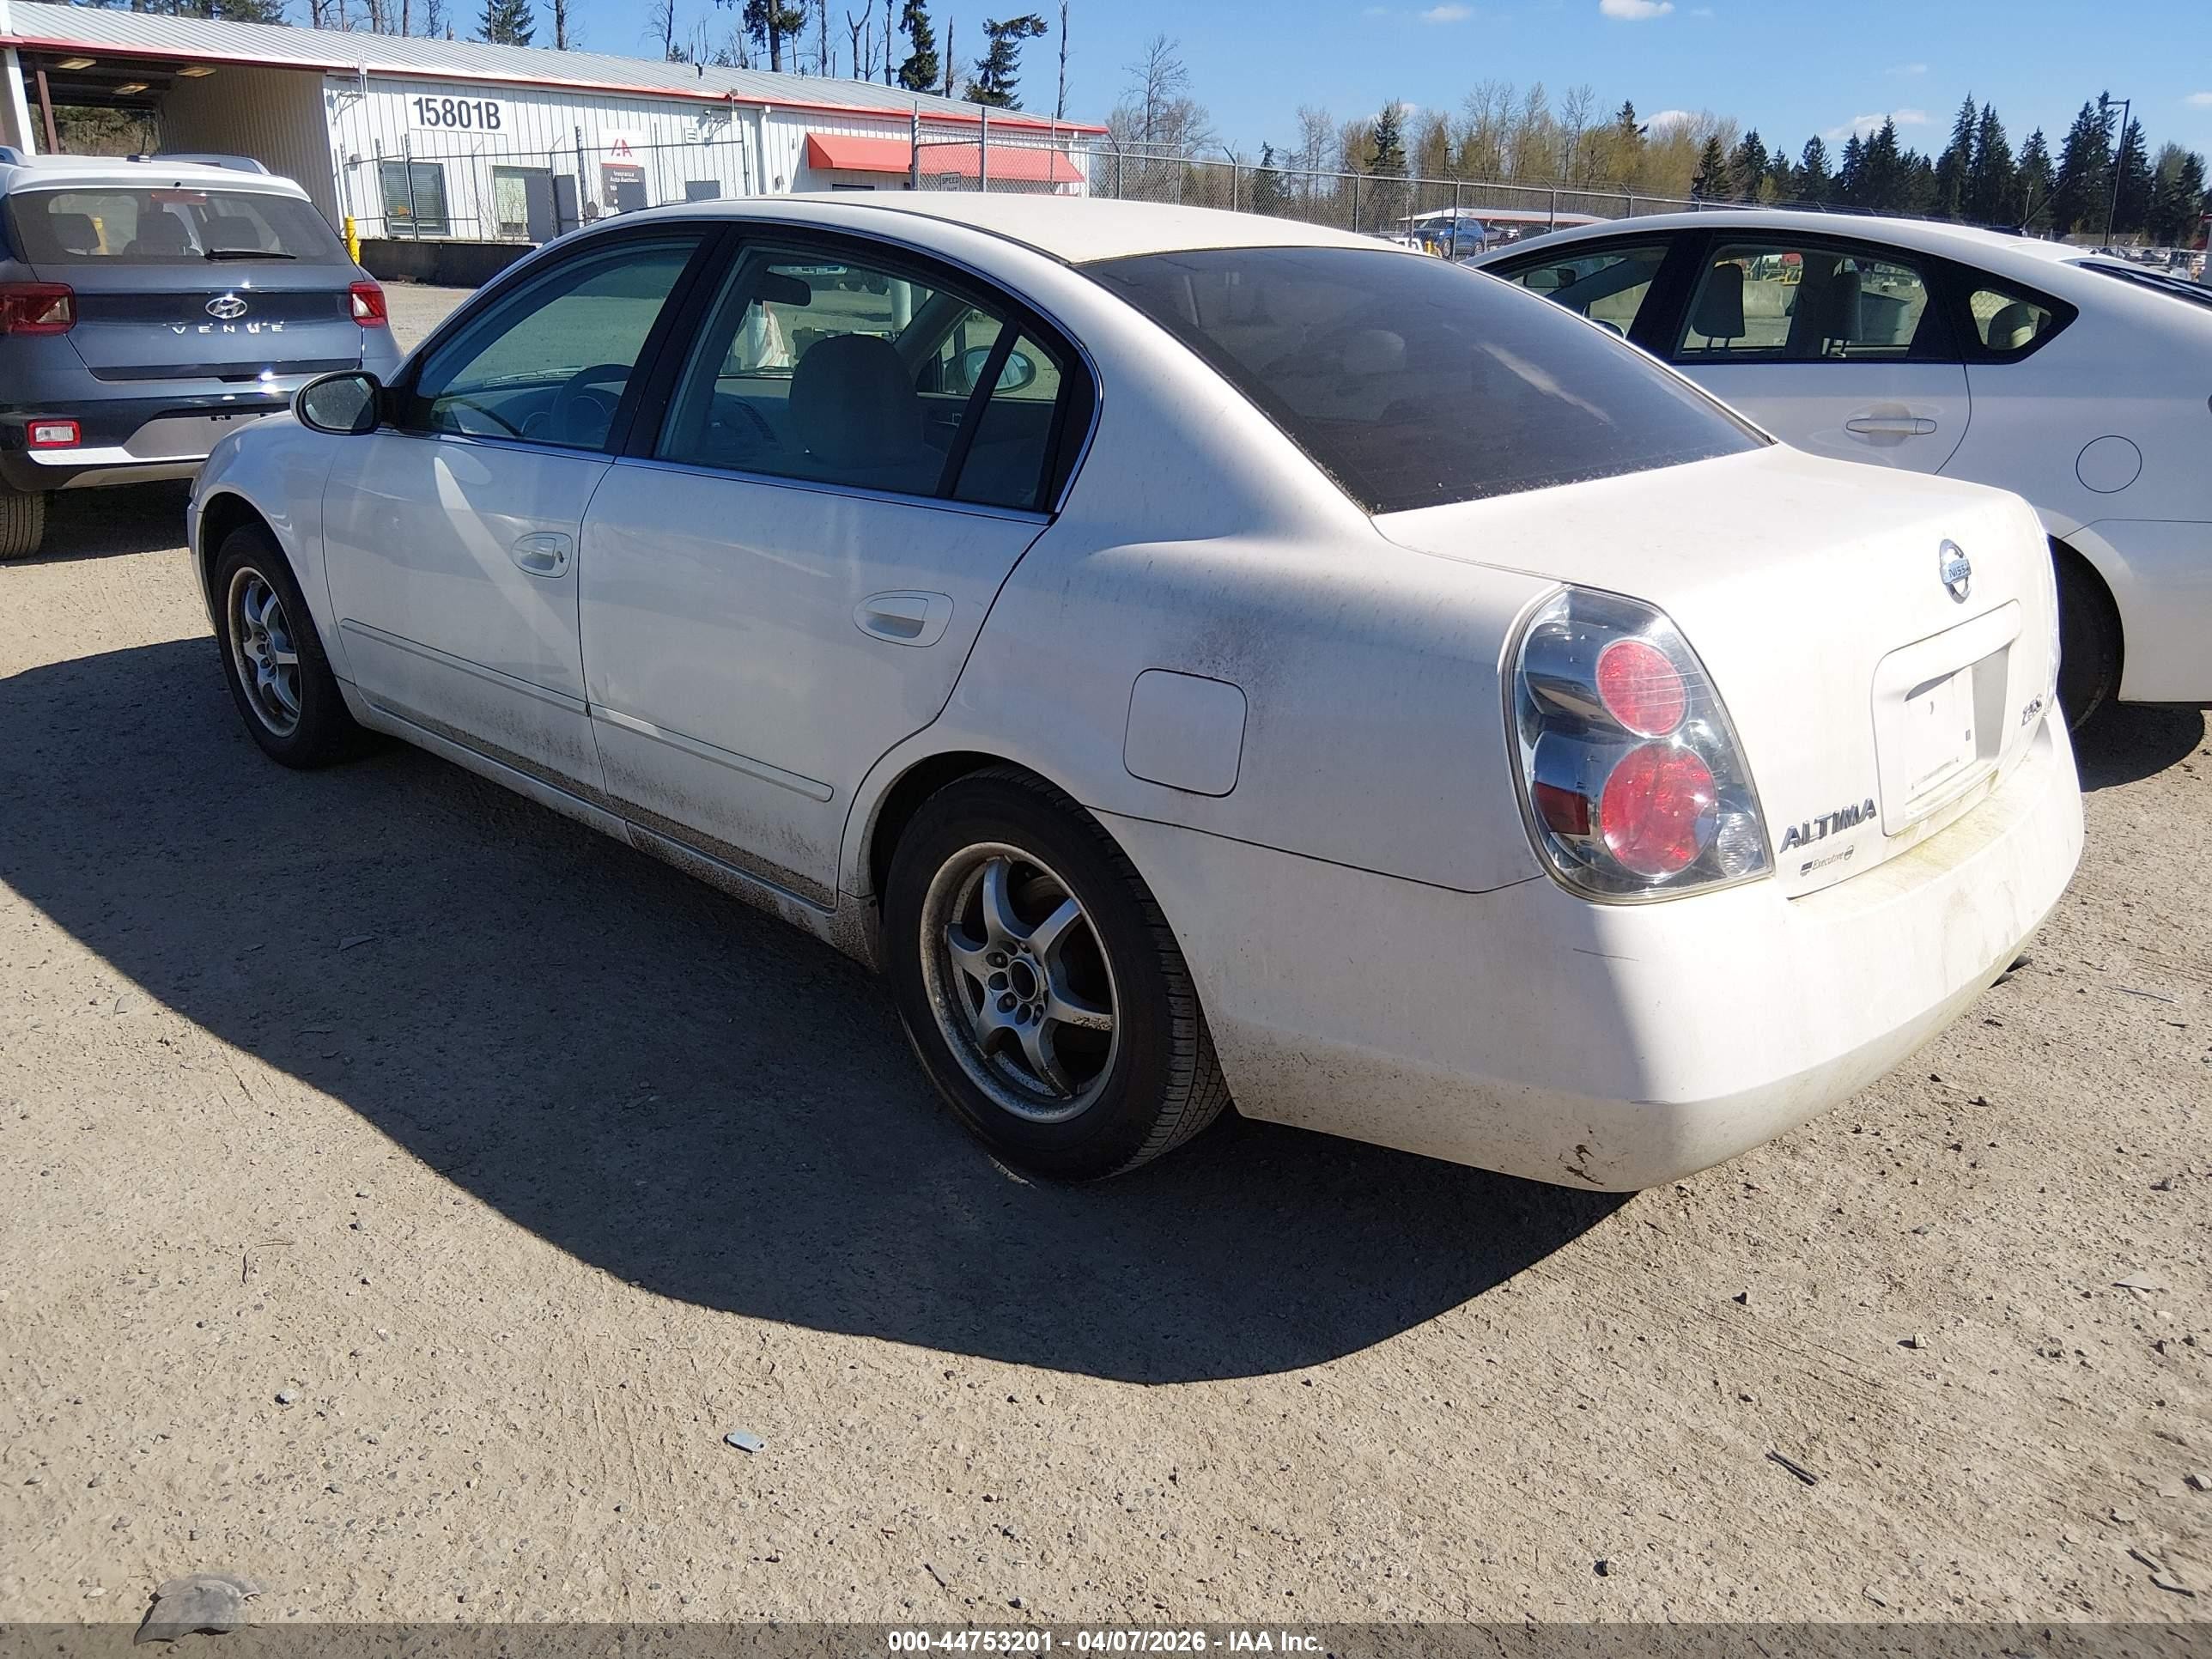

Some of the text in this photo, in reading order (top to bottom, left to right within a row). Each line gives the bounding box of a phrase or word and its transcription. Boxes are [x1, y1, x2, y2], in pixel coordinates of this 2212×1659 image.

[412, 96, 501, 130] 15801B
[172, 322, 283, 334] VENUE
[1779, 798, 1877, 854] ALTIMA
[1812, 851, 1844, 871] Executive
